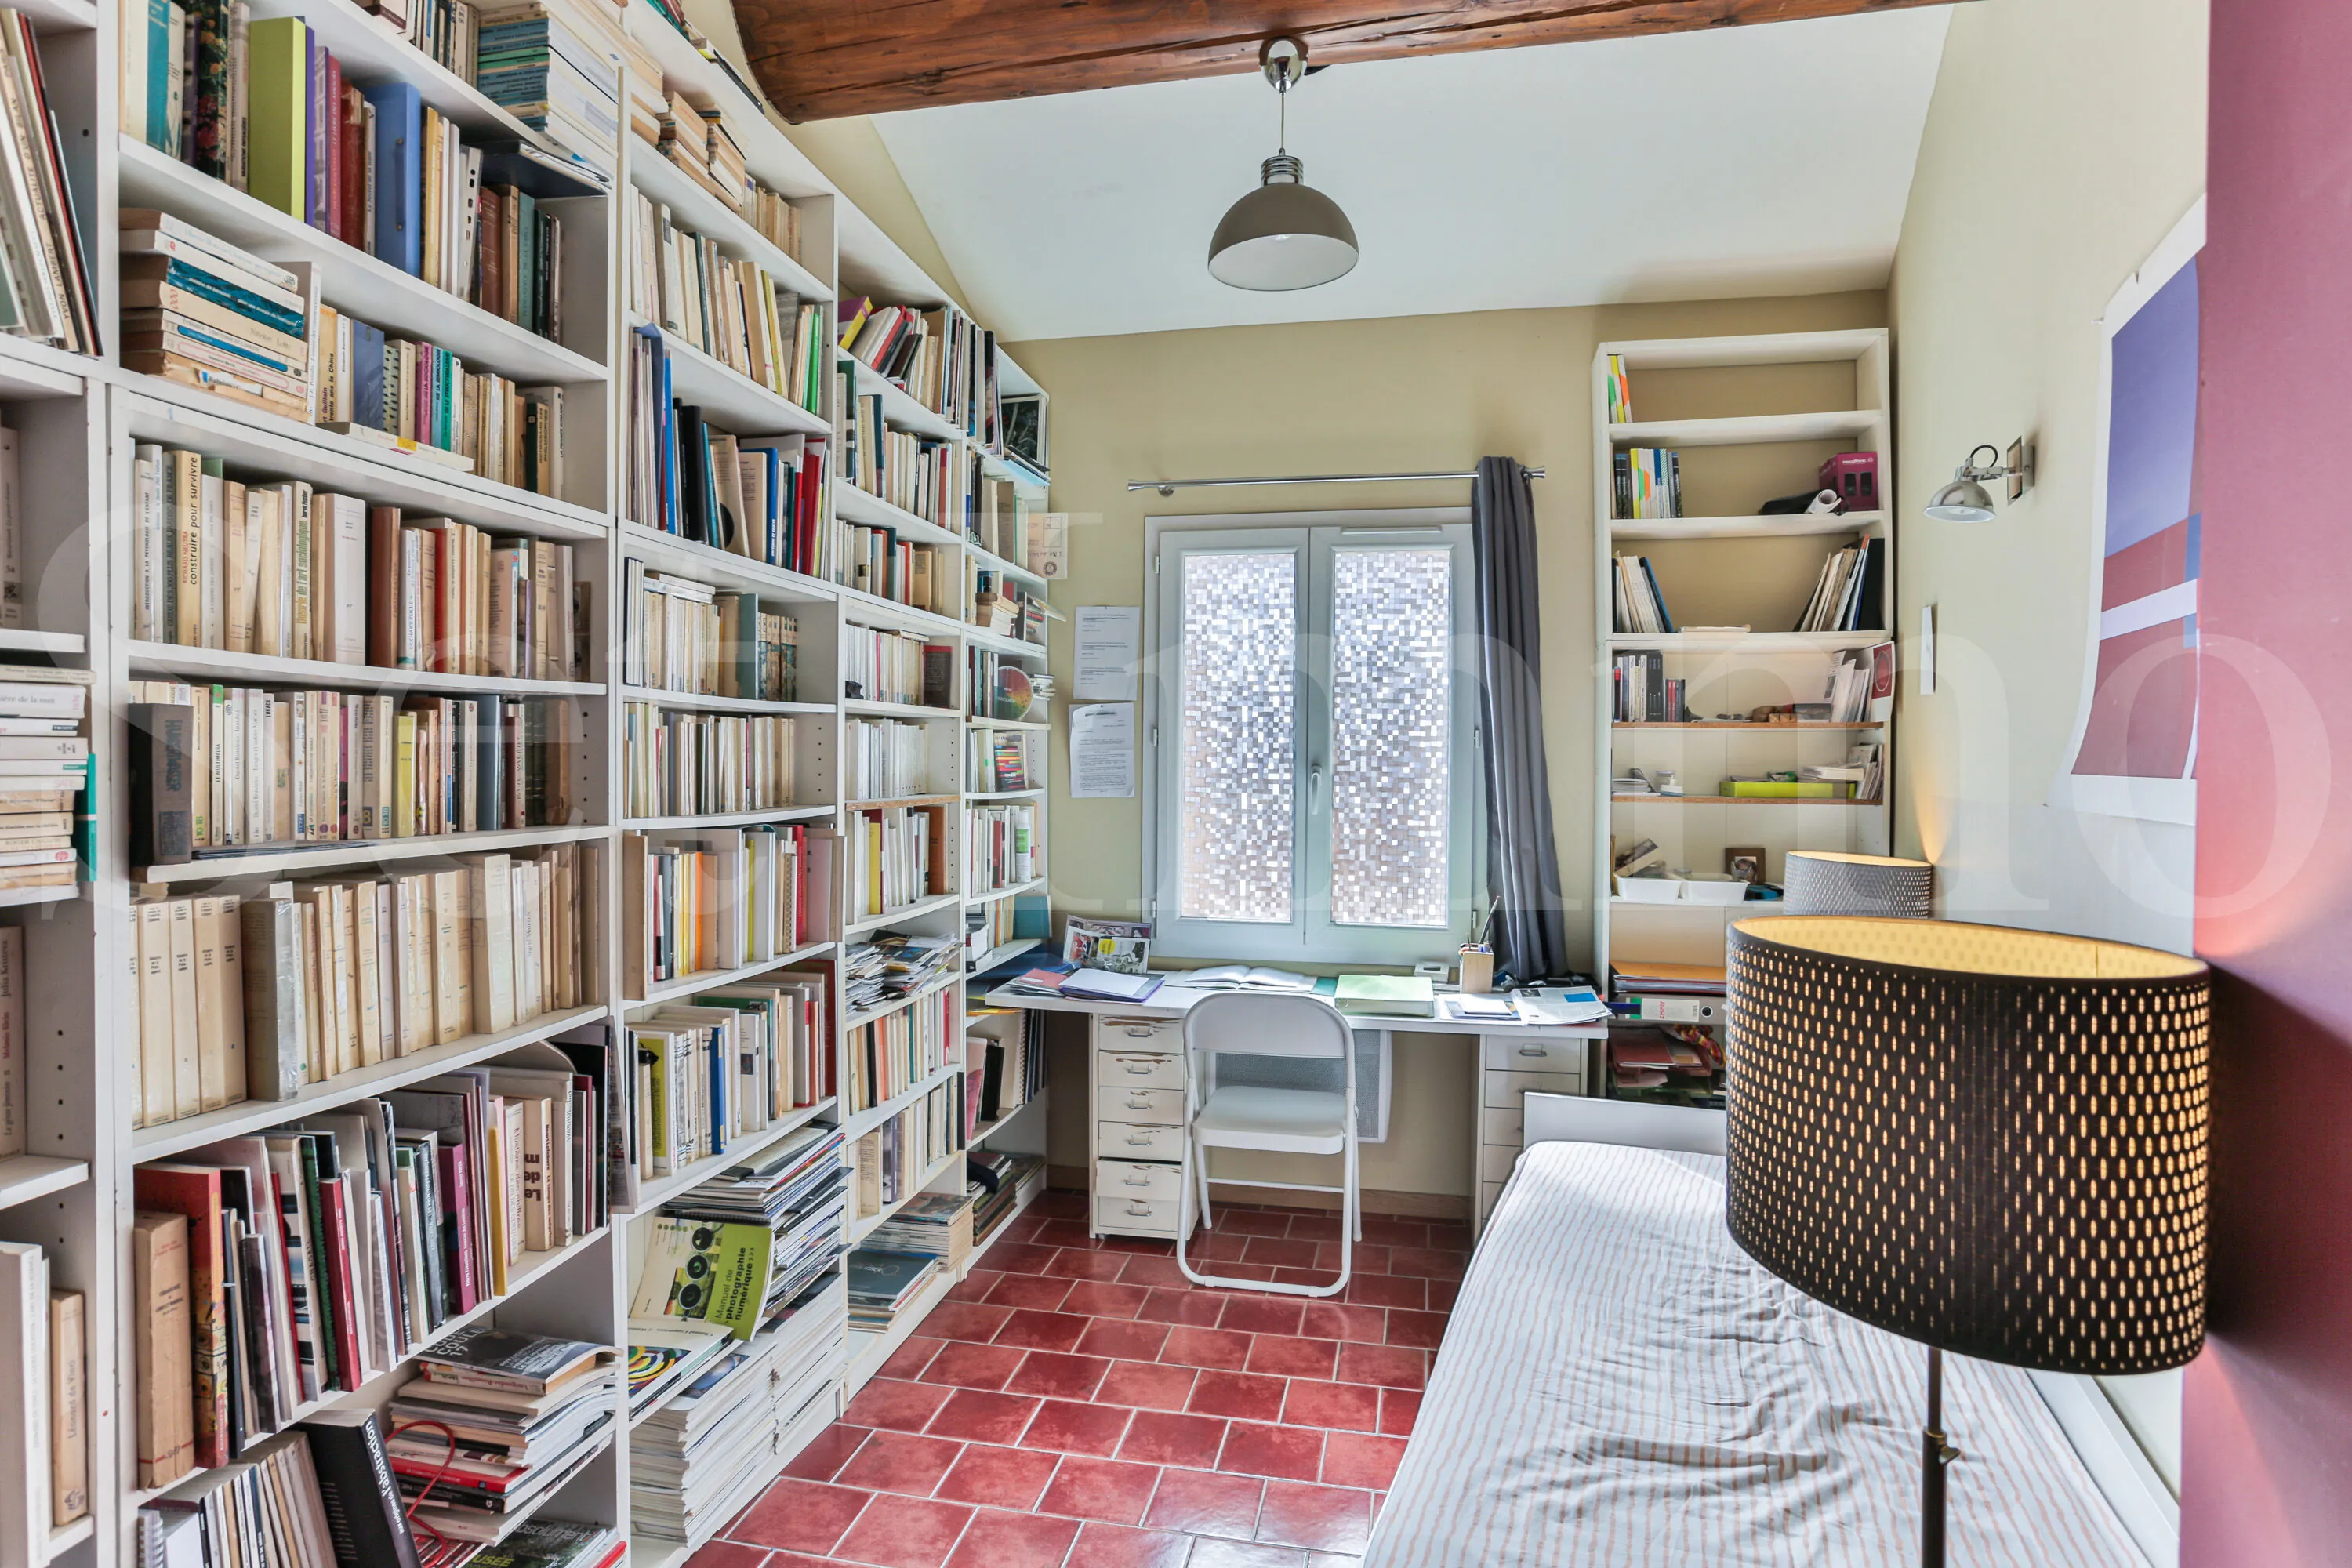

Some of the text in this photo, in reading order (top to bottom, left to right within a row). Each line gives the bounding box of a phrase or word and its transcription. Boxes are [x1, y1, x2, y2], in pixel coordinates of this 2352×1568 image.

[46, 242, 64, 292] LAMBERT
[189, 503, 199, 527] pour
[295, 520, 307, 567] sociologique
[0, 940, 9, 974] Kristeva
[1, 977, 11, 996] Julia
[524, 1189, 541, 1200] Le
[306, 1241, 314, 1280] CHAGALL
[725, 1247, 746, 1320] photographie
[714, 1269, 733, 1319] Manuel de
[735, 1262, 754, 1321] numérique
[67, 1359, 77, 1437] Léonard de Vinci
[364, 1418, 392, 1498] l'abstraction
